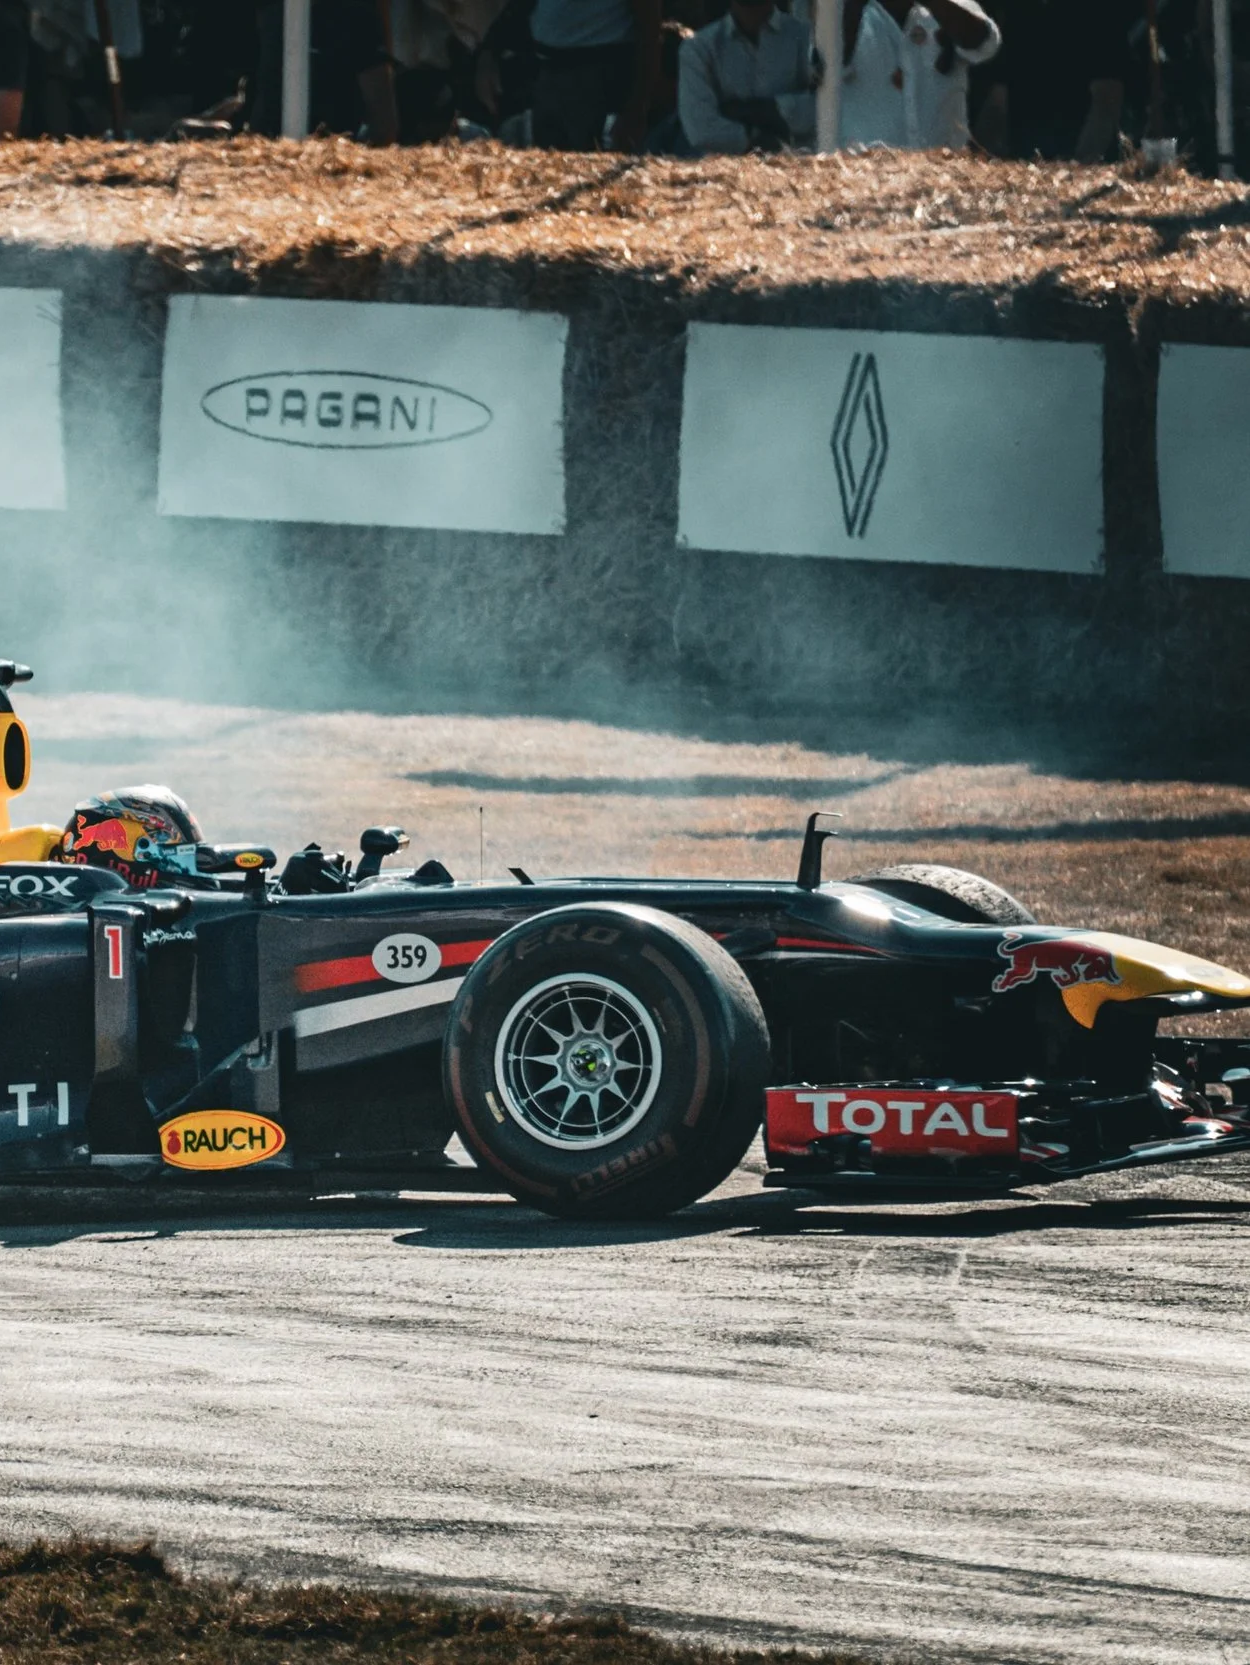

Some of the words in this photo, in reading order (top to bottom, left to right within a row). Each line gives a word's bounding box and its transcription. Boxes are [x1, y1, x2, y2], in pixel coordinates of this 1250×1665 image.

[245, 388, 437, 432] PAGANI
[104, 924, 123, 979] 1
[387, 945, 427, 969] 359
[795, 1092, 1009, 1138] TOTAL
[183, 1127, 266, 1153] RAUCH
